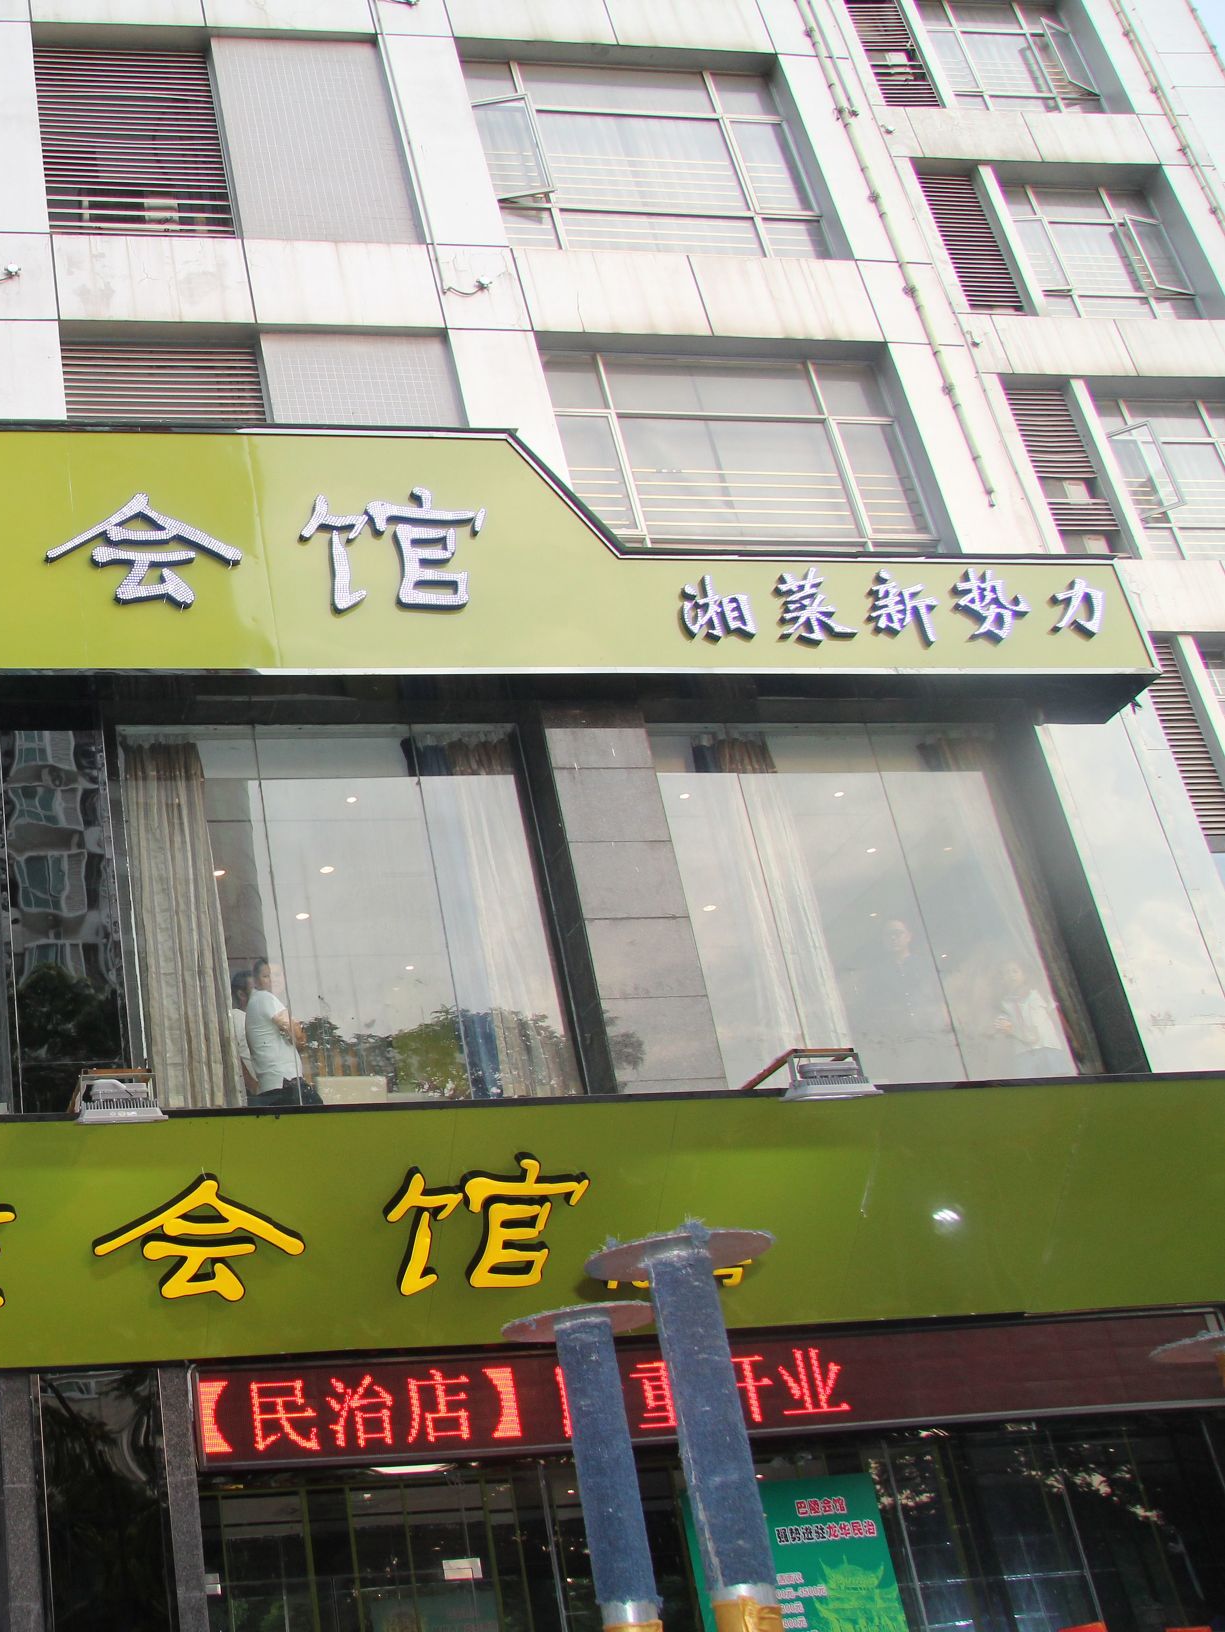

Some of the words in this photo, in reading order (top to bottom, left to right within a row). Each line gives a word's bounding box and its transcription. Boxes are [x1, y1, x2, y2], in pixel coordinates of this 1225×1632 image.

[679, 566, 1107, 647] 湘菜新势力
